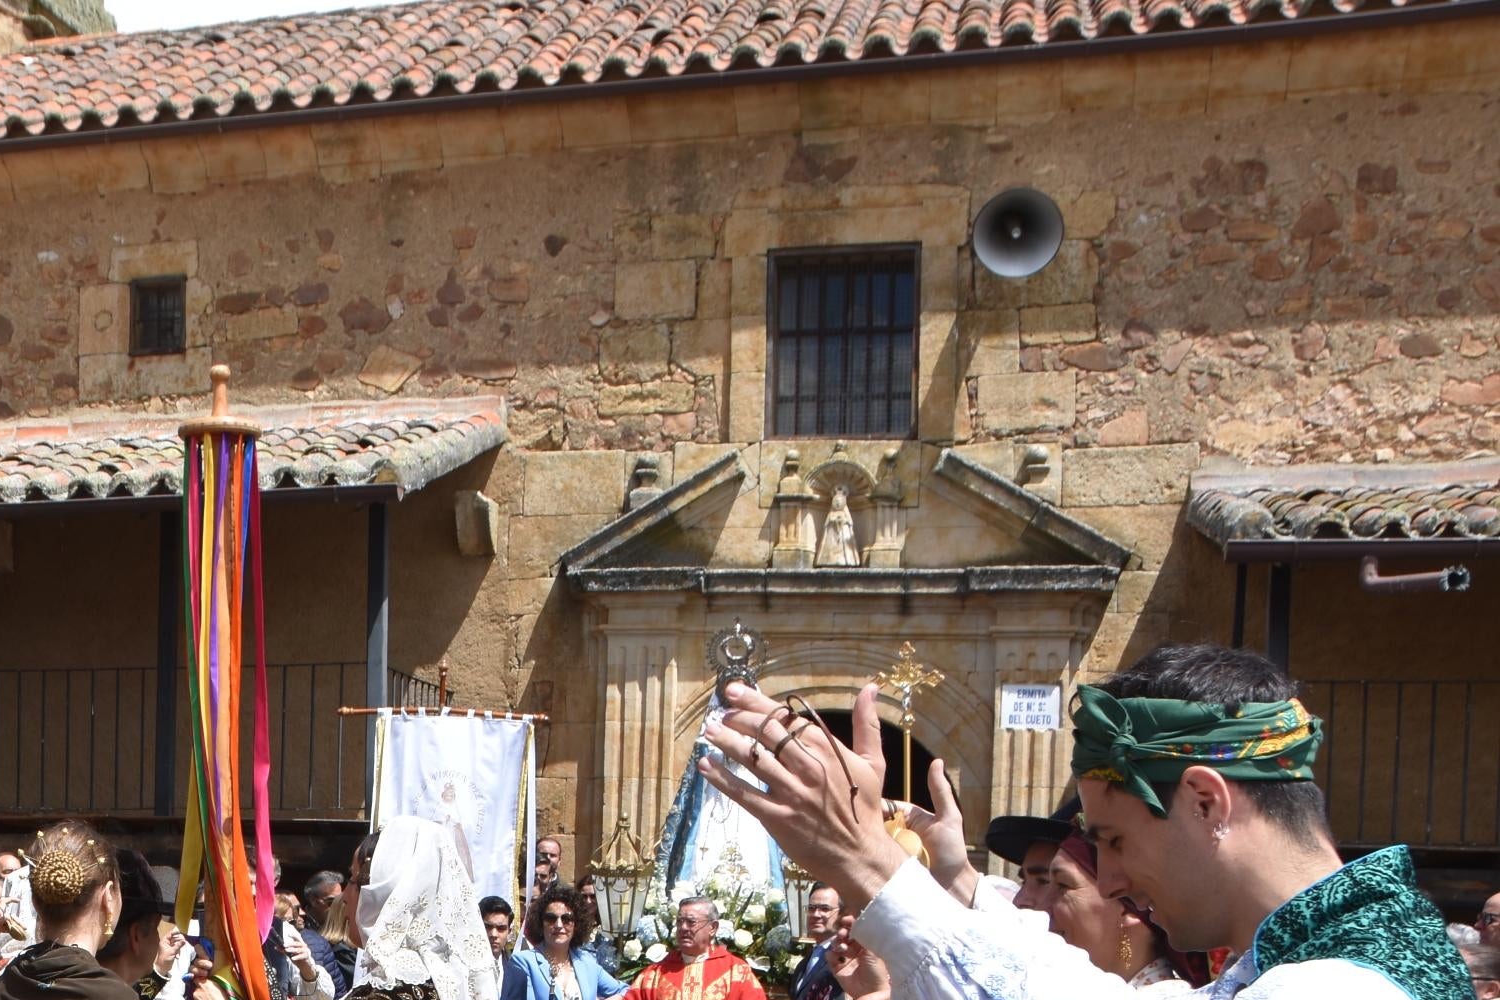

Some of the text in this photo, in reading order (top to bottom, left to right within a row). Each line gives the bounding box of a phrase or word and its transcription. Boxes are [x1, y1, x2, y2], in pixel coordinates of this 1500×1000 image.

[1017, 688, 1046, 699] ERMITA
[1013, 702, 1024, 712] DE
[1008, 714, 1051, 725] DEL CUETO
